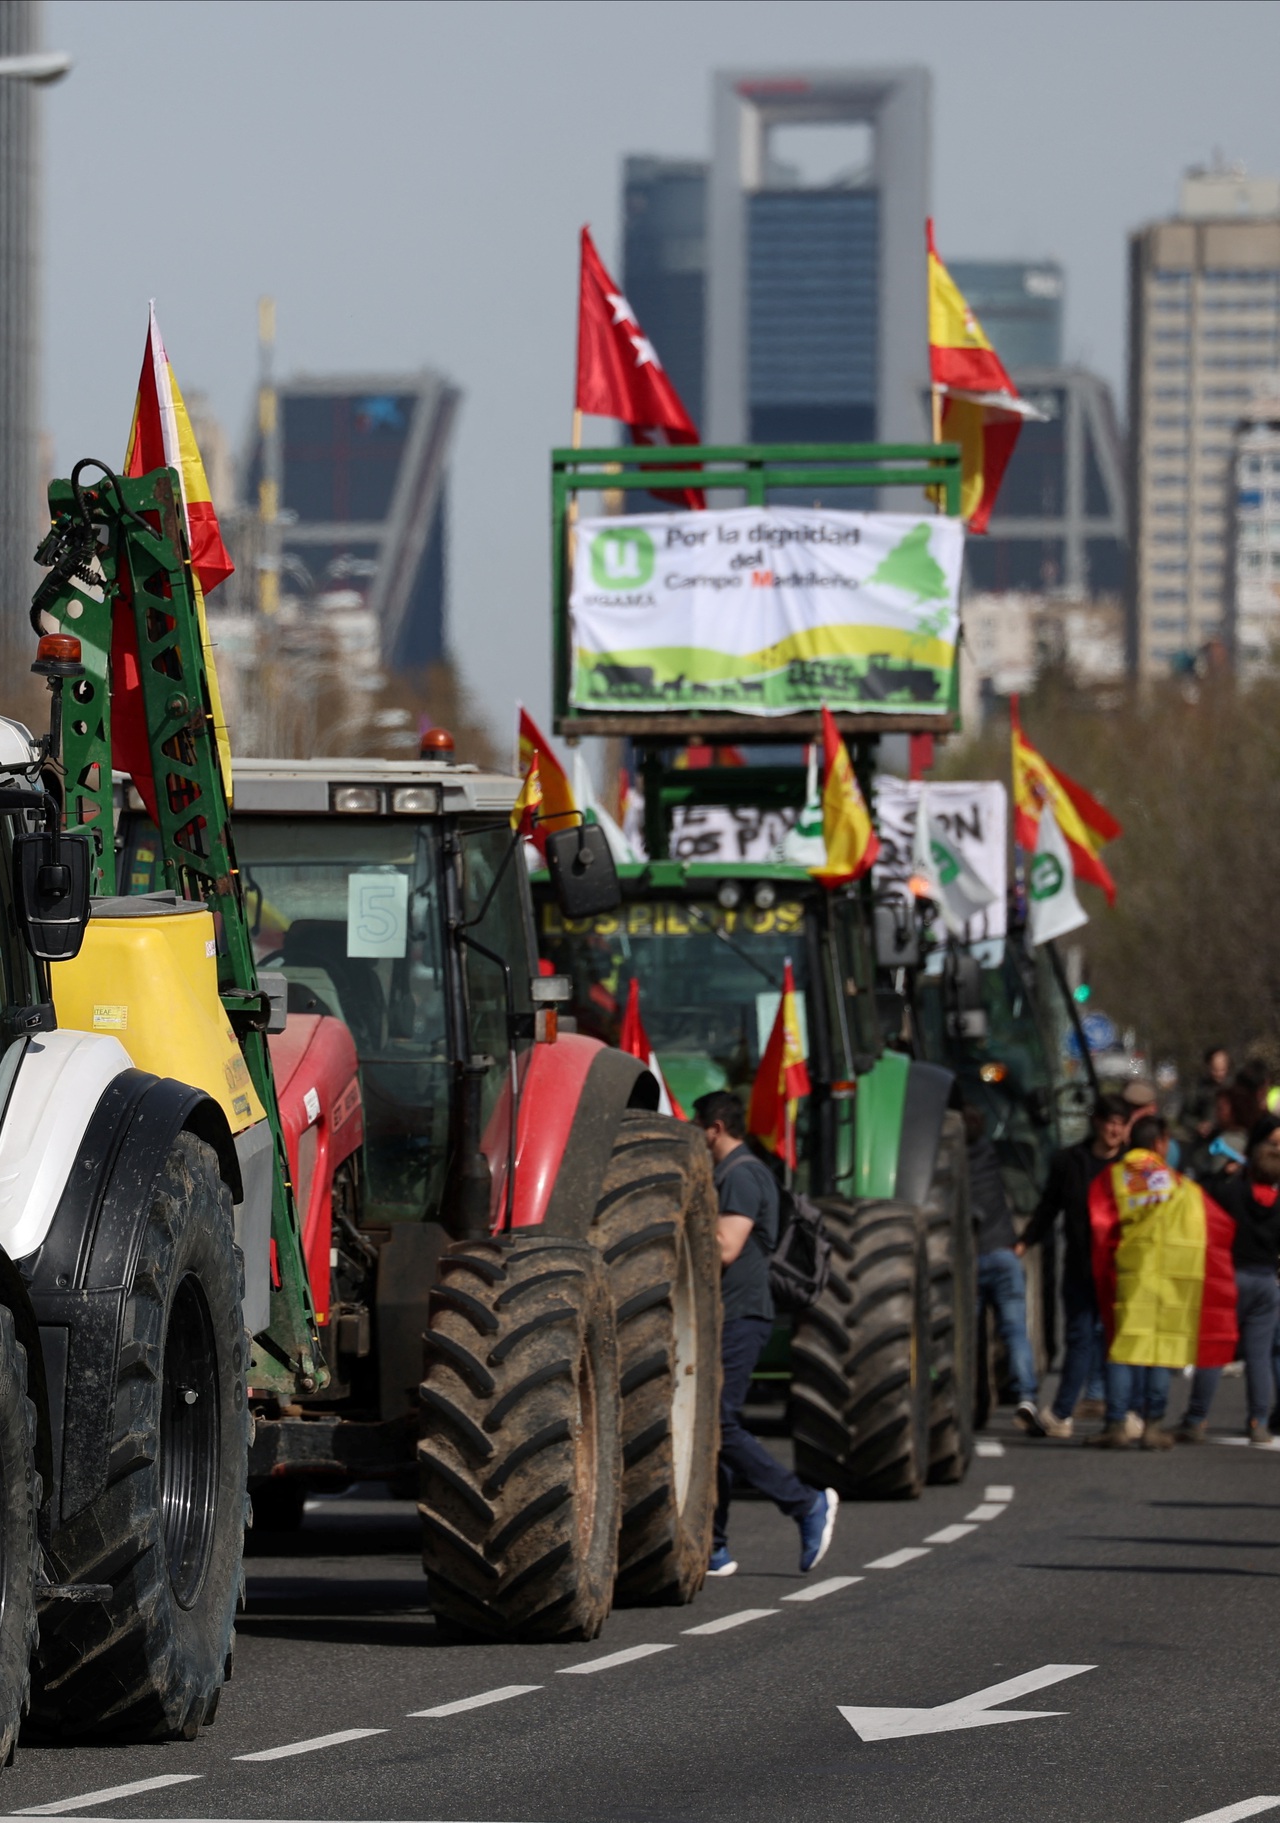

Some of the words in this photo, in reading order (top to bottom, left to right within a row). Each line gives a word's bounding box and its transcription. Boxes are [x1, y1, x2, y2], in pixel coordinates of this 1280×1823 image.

[665, 527, 707, 549] Por
[719, 525, 741, 546] la
[748, 523, 861, 547] dignidad
[729, 549, 764, 570] del
[664, 572, 742, 592] Campo
[356, 886, 399, 944] 5
